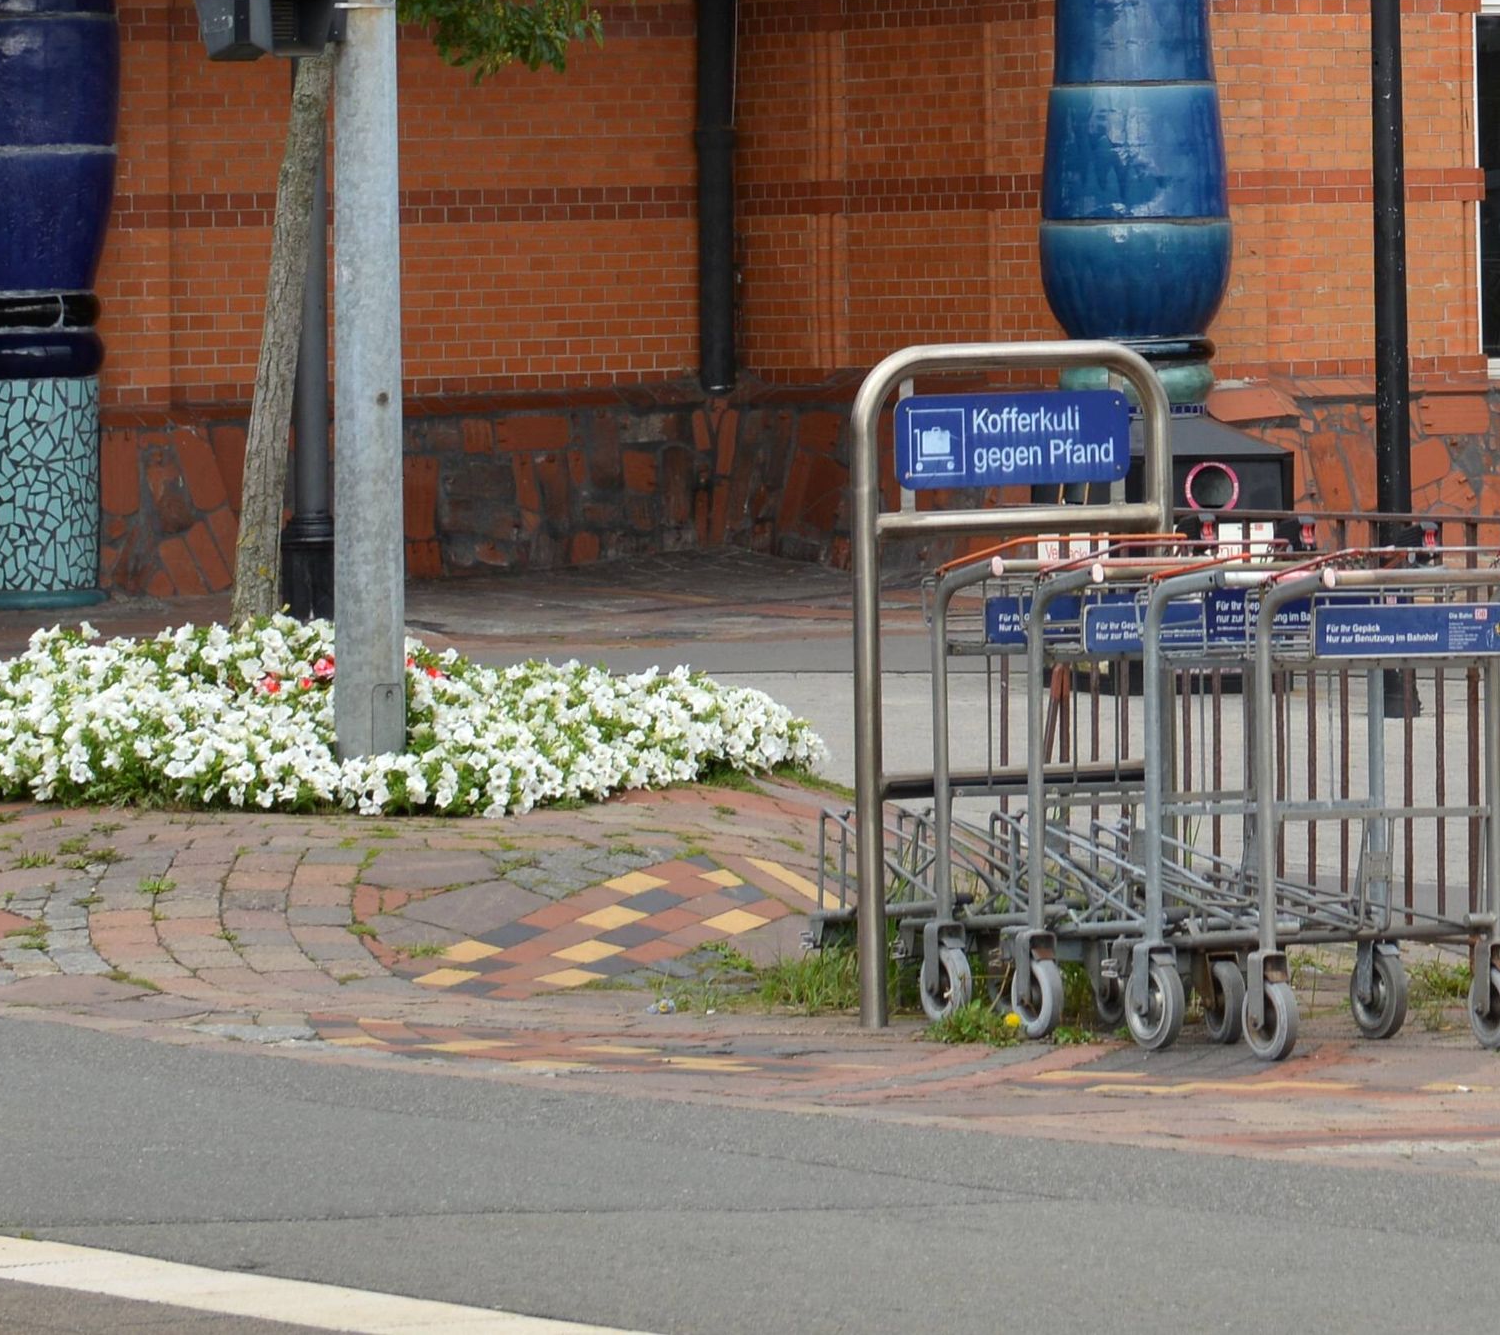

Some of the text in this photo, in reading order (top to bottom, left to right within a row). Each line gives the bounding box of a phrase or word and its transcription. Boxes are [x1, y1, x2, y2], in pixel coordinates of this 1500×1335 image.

[973, 405, 1080, 434] Kofferkuli
[974, 437, 1114, 473] gegen Pfand
[1215, 600, 1229, 611] Für
[1216, 614, 1229, 623] nur
[1231, 614, 1244, 623] zur
[1289, 612, 1299, 622] im
[1326, 624, 1339, 633] Für
[1352, 623, 1380, 634] Gepäck
[1326, 632, 1439, 644] Nur zur Benutzung im Bahnhof
